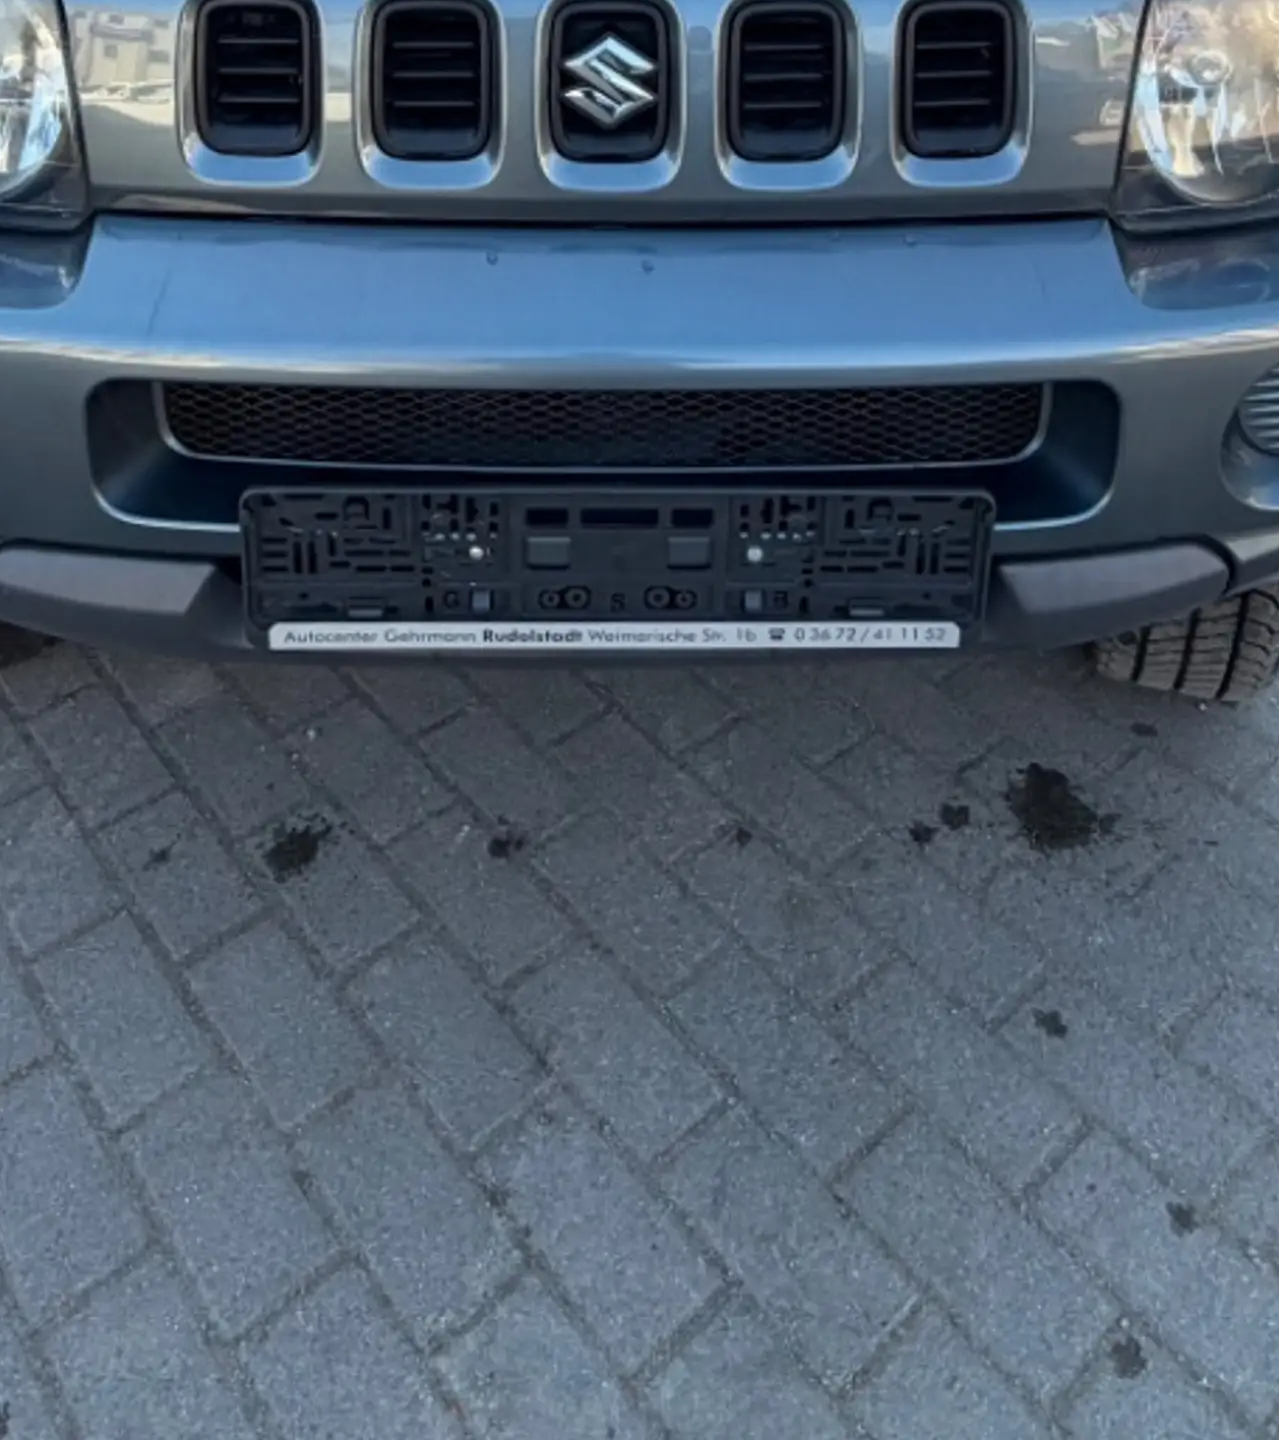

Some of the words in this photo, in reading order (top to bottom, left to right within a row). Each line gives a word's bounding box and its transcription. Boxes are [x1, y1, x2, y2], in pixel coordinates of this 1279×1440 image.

[283, 629, 378, 643] Autocenter
[384, 628, 477, 643] Gehrmann
[482, 627, 583, 643] Rudolstadt
[588, 627, 698, 643] Weimarische
